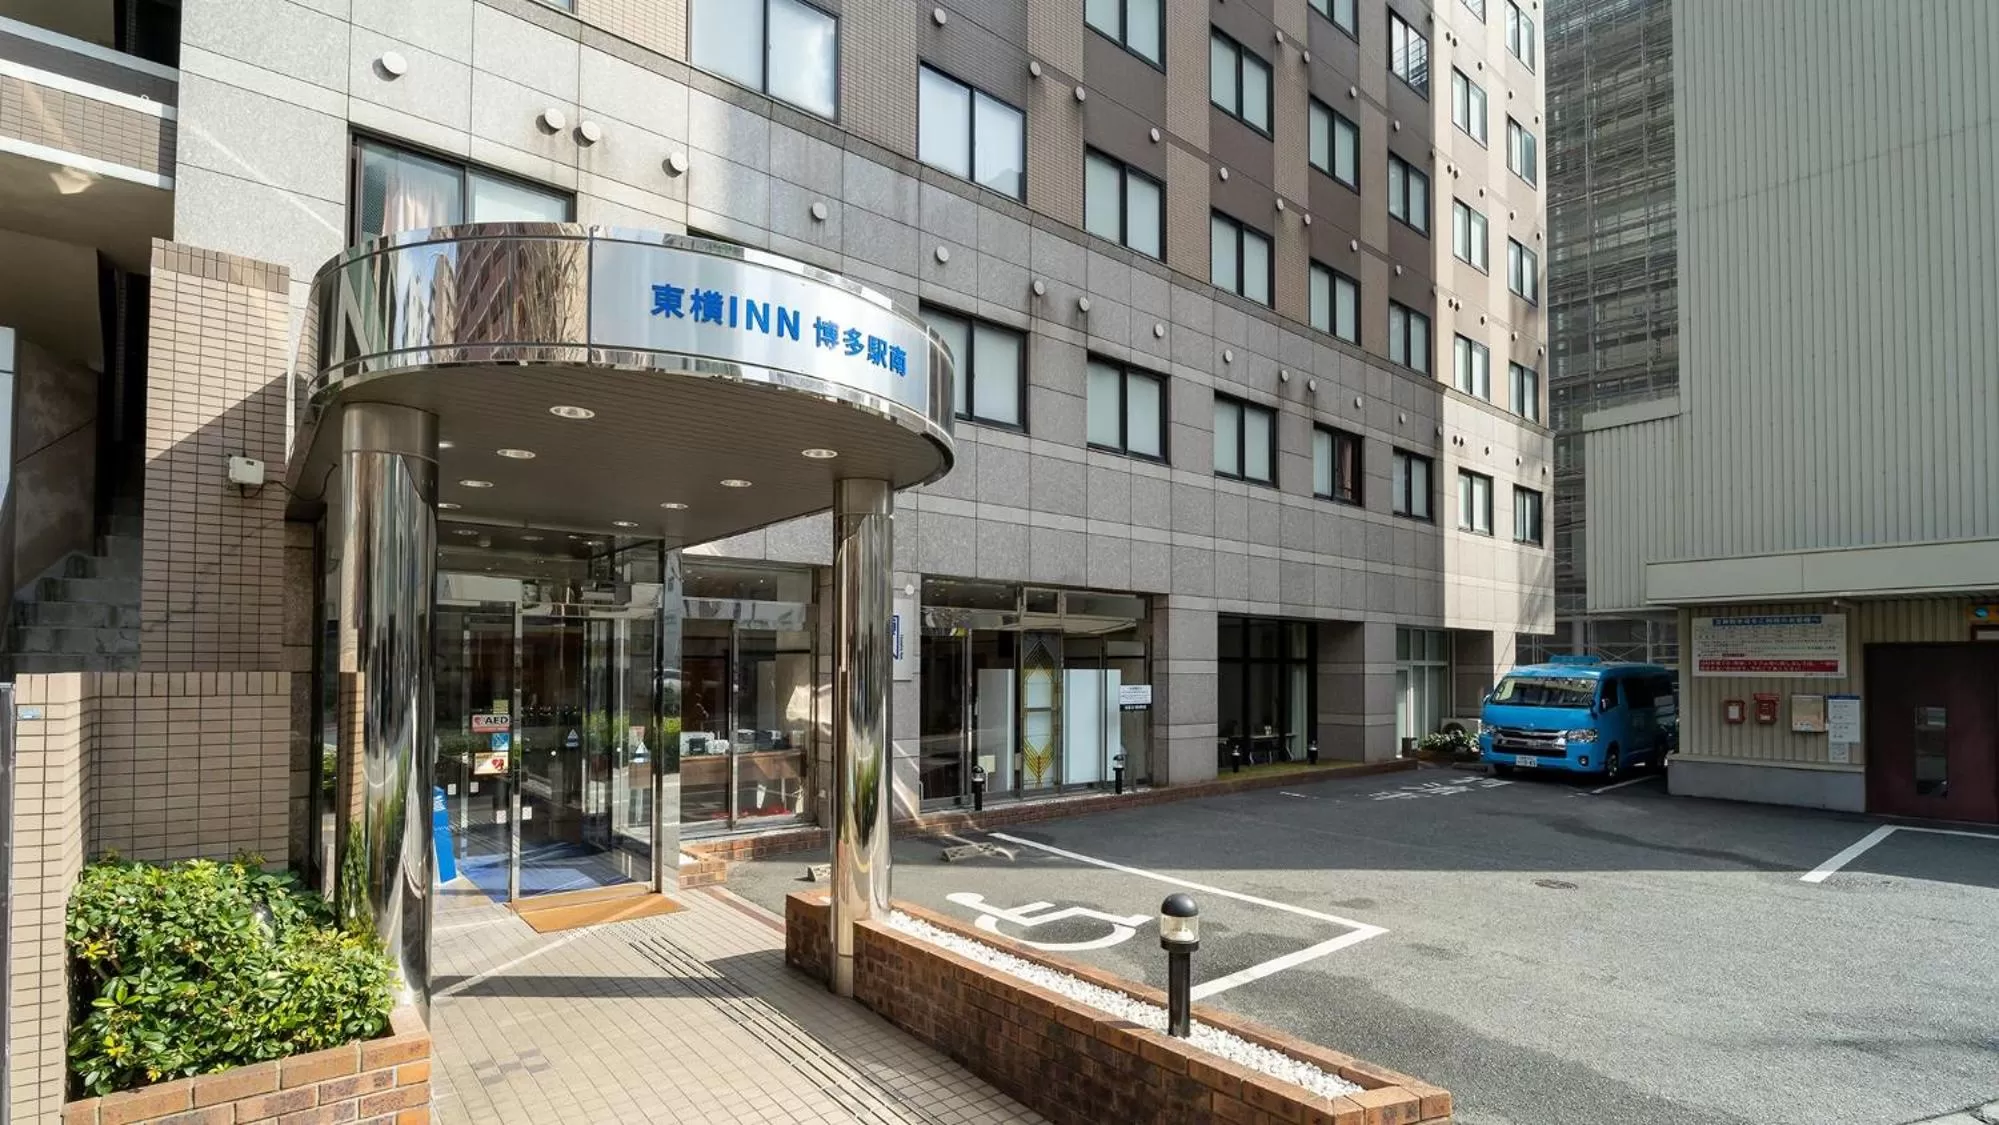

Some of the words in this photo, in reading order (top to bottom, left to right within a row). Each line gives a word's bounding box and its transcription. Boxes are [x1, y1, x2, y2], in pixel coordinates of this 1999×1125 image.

[651, 284, 801, 341] 東横INN
[813, 318, 907, 377] 博多駅南
[486, 716, 509, 725] AED
